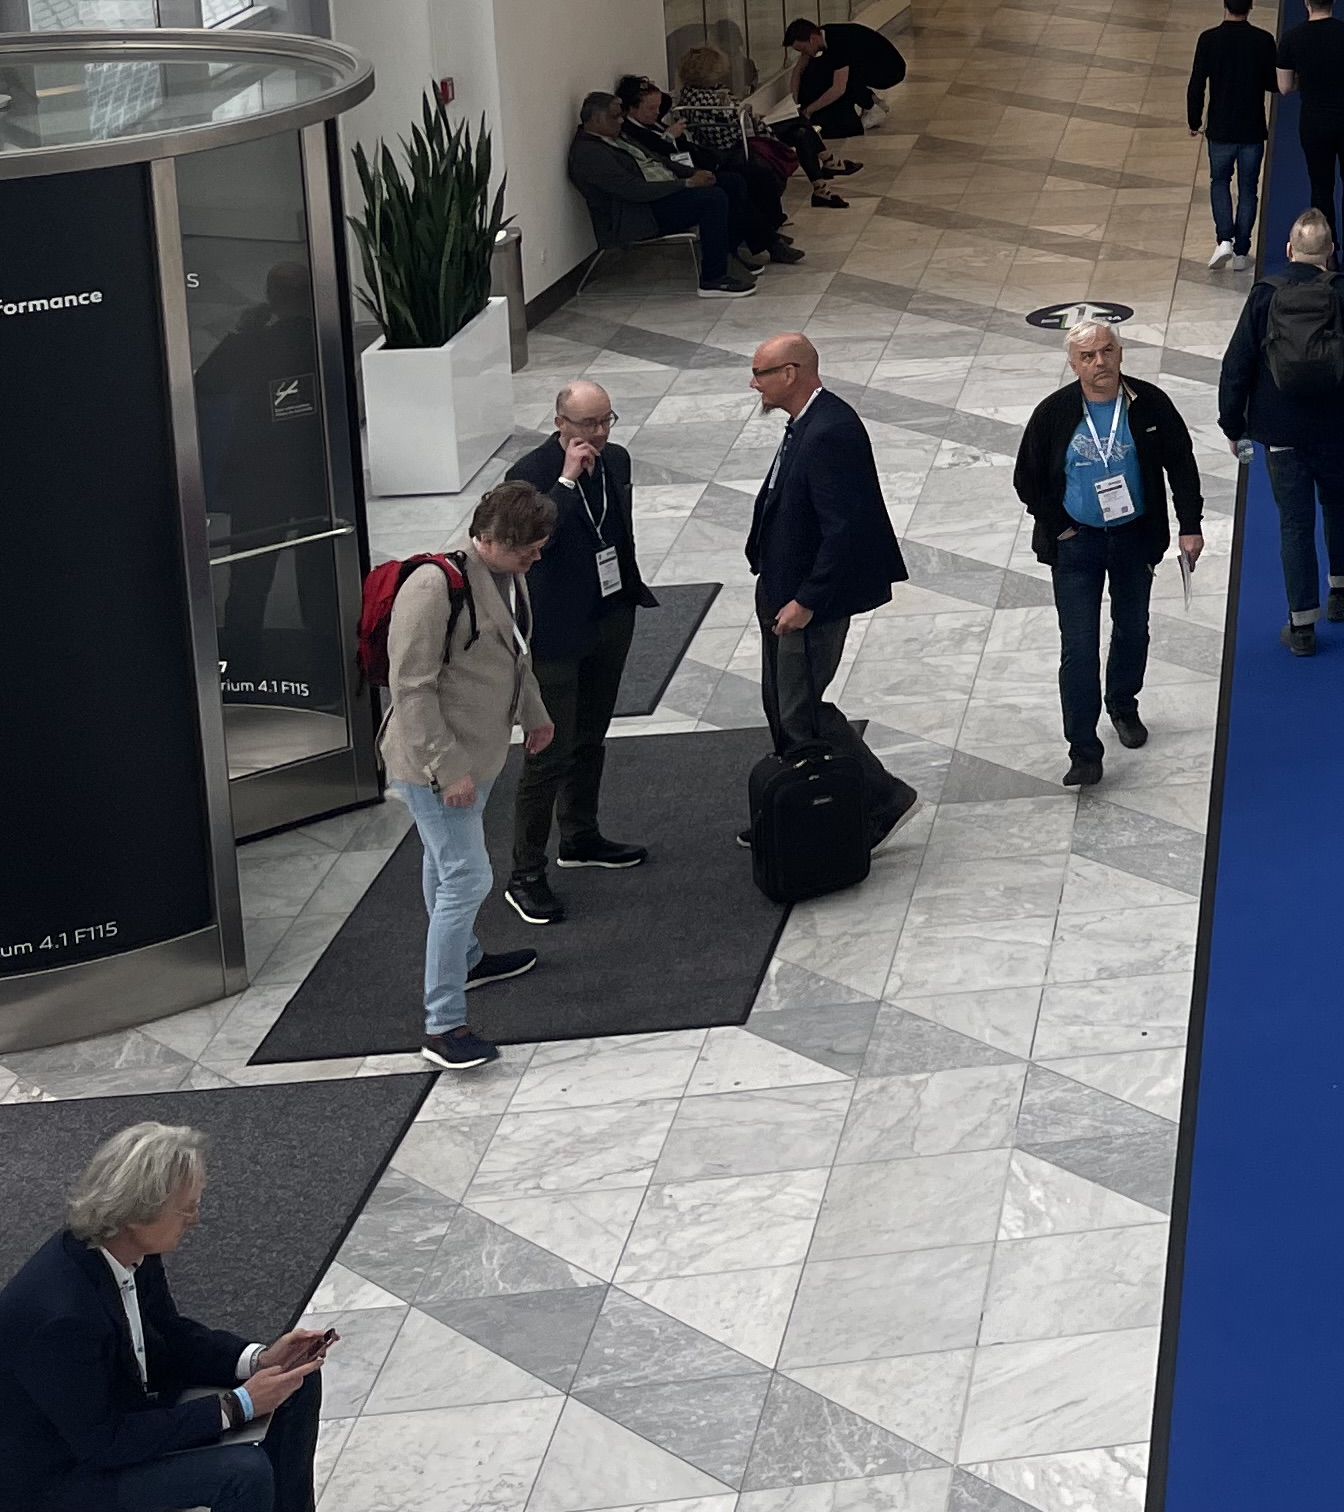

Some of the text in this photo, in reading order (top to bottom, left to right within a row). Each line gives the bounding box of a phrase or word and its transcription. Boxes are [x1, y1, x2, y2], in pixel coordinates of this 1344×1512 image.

[258, 679, 278, 693] 4.1
[281, 681, 310, 697] F115
[39, 932, 67, 949] 4.1
[75, 920, 118, 944] F115
